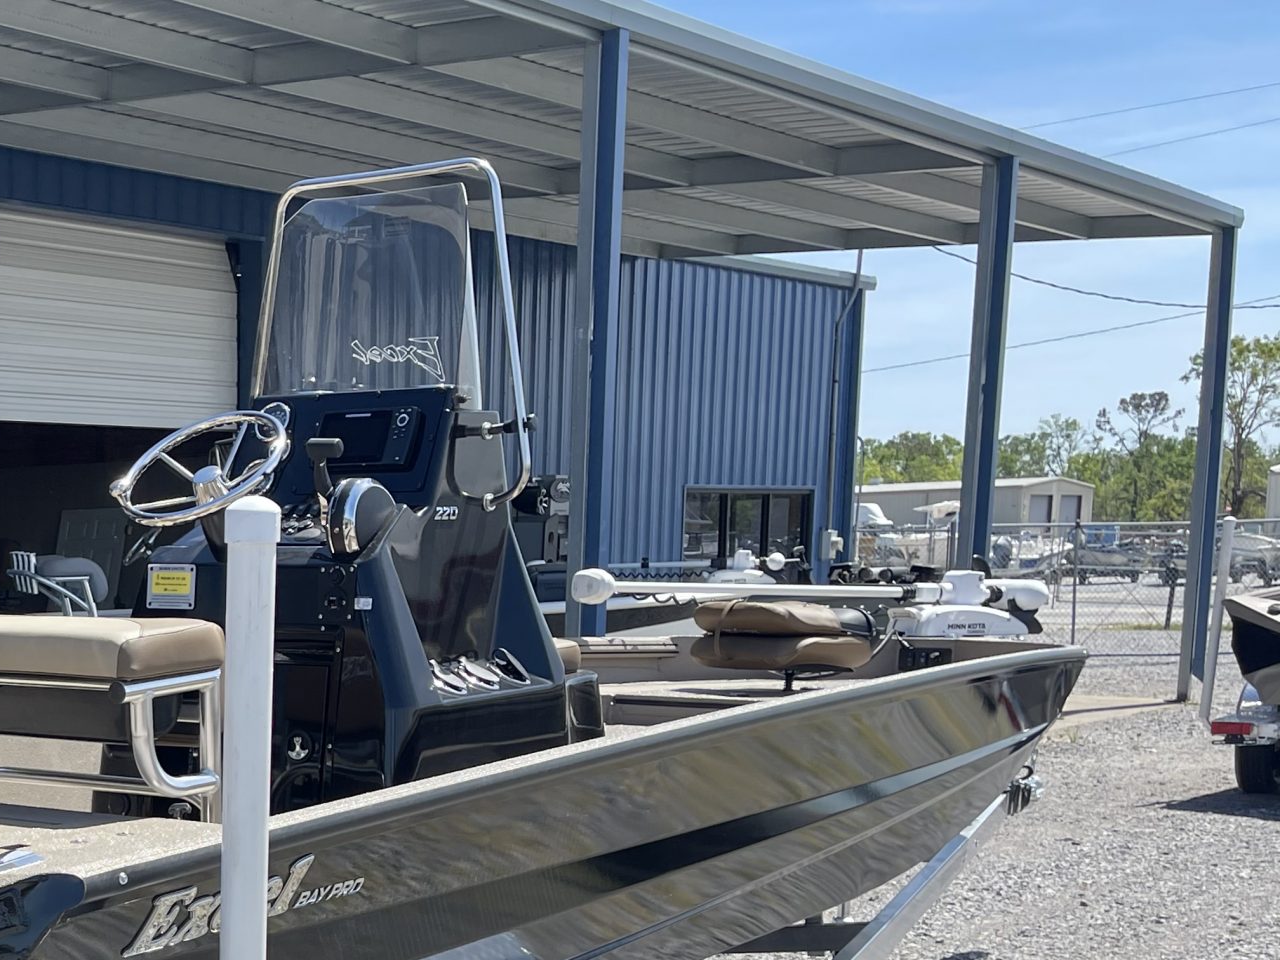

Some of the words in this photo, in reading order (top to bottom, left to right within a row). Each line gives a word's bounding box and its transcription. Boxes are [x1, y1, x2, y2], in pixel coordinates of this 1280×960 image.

[434, 506, 459, 521] 220
[293, 884, 332, 909] BAY
[328, 877, 365, 900] PRO
